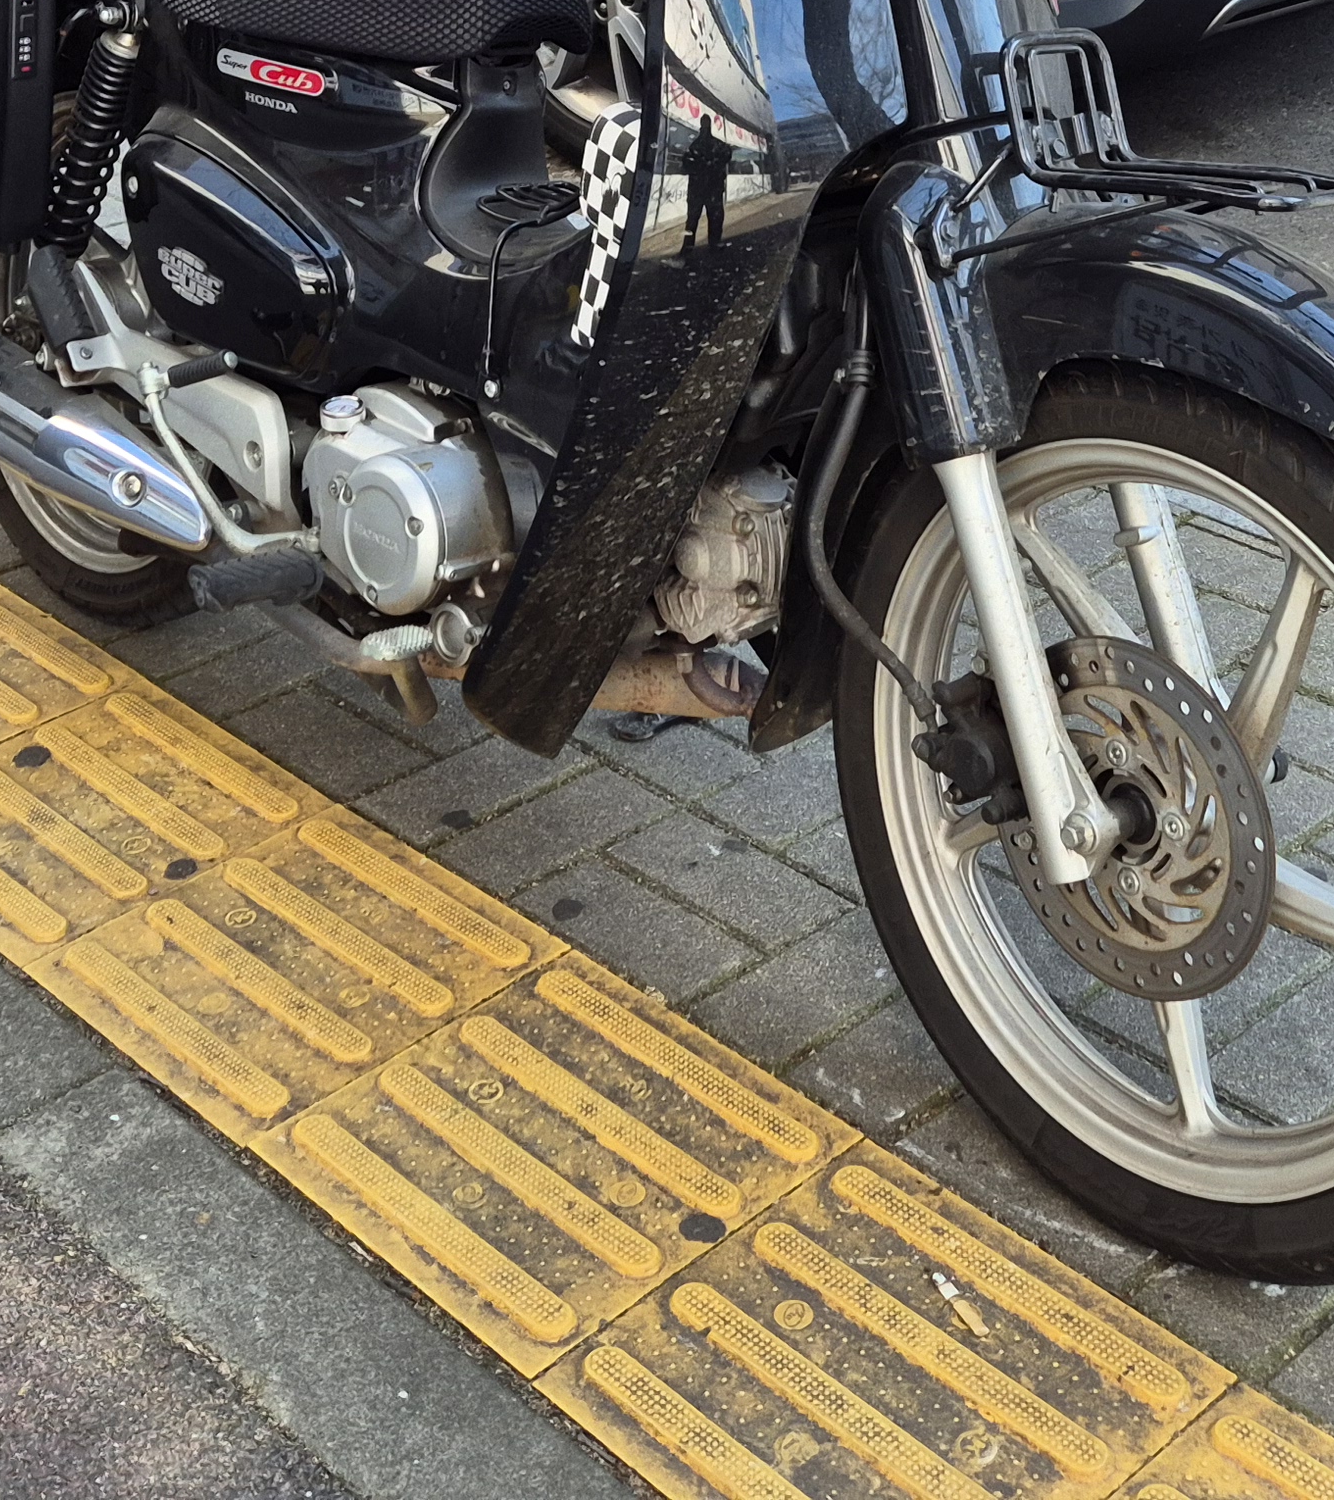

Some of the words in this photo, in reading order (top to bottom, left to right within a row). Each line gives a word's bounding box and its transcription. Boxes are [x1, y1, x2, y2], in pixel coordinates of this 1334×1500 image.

[220, 54, 247, 70] Super
[258, 64, 313, 90] Cub
[244, 90, 298, 114] HONDA
